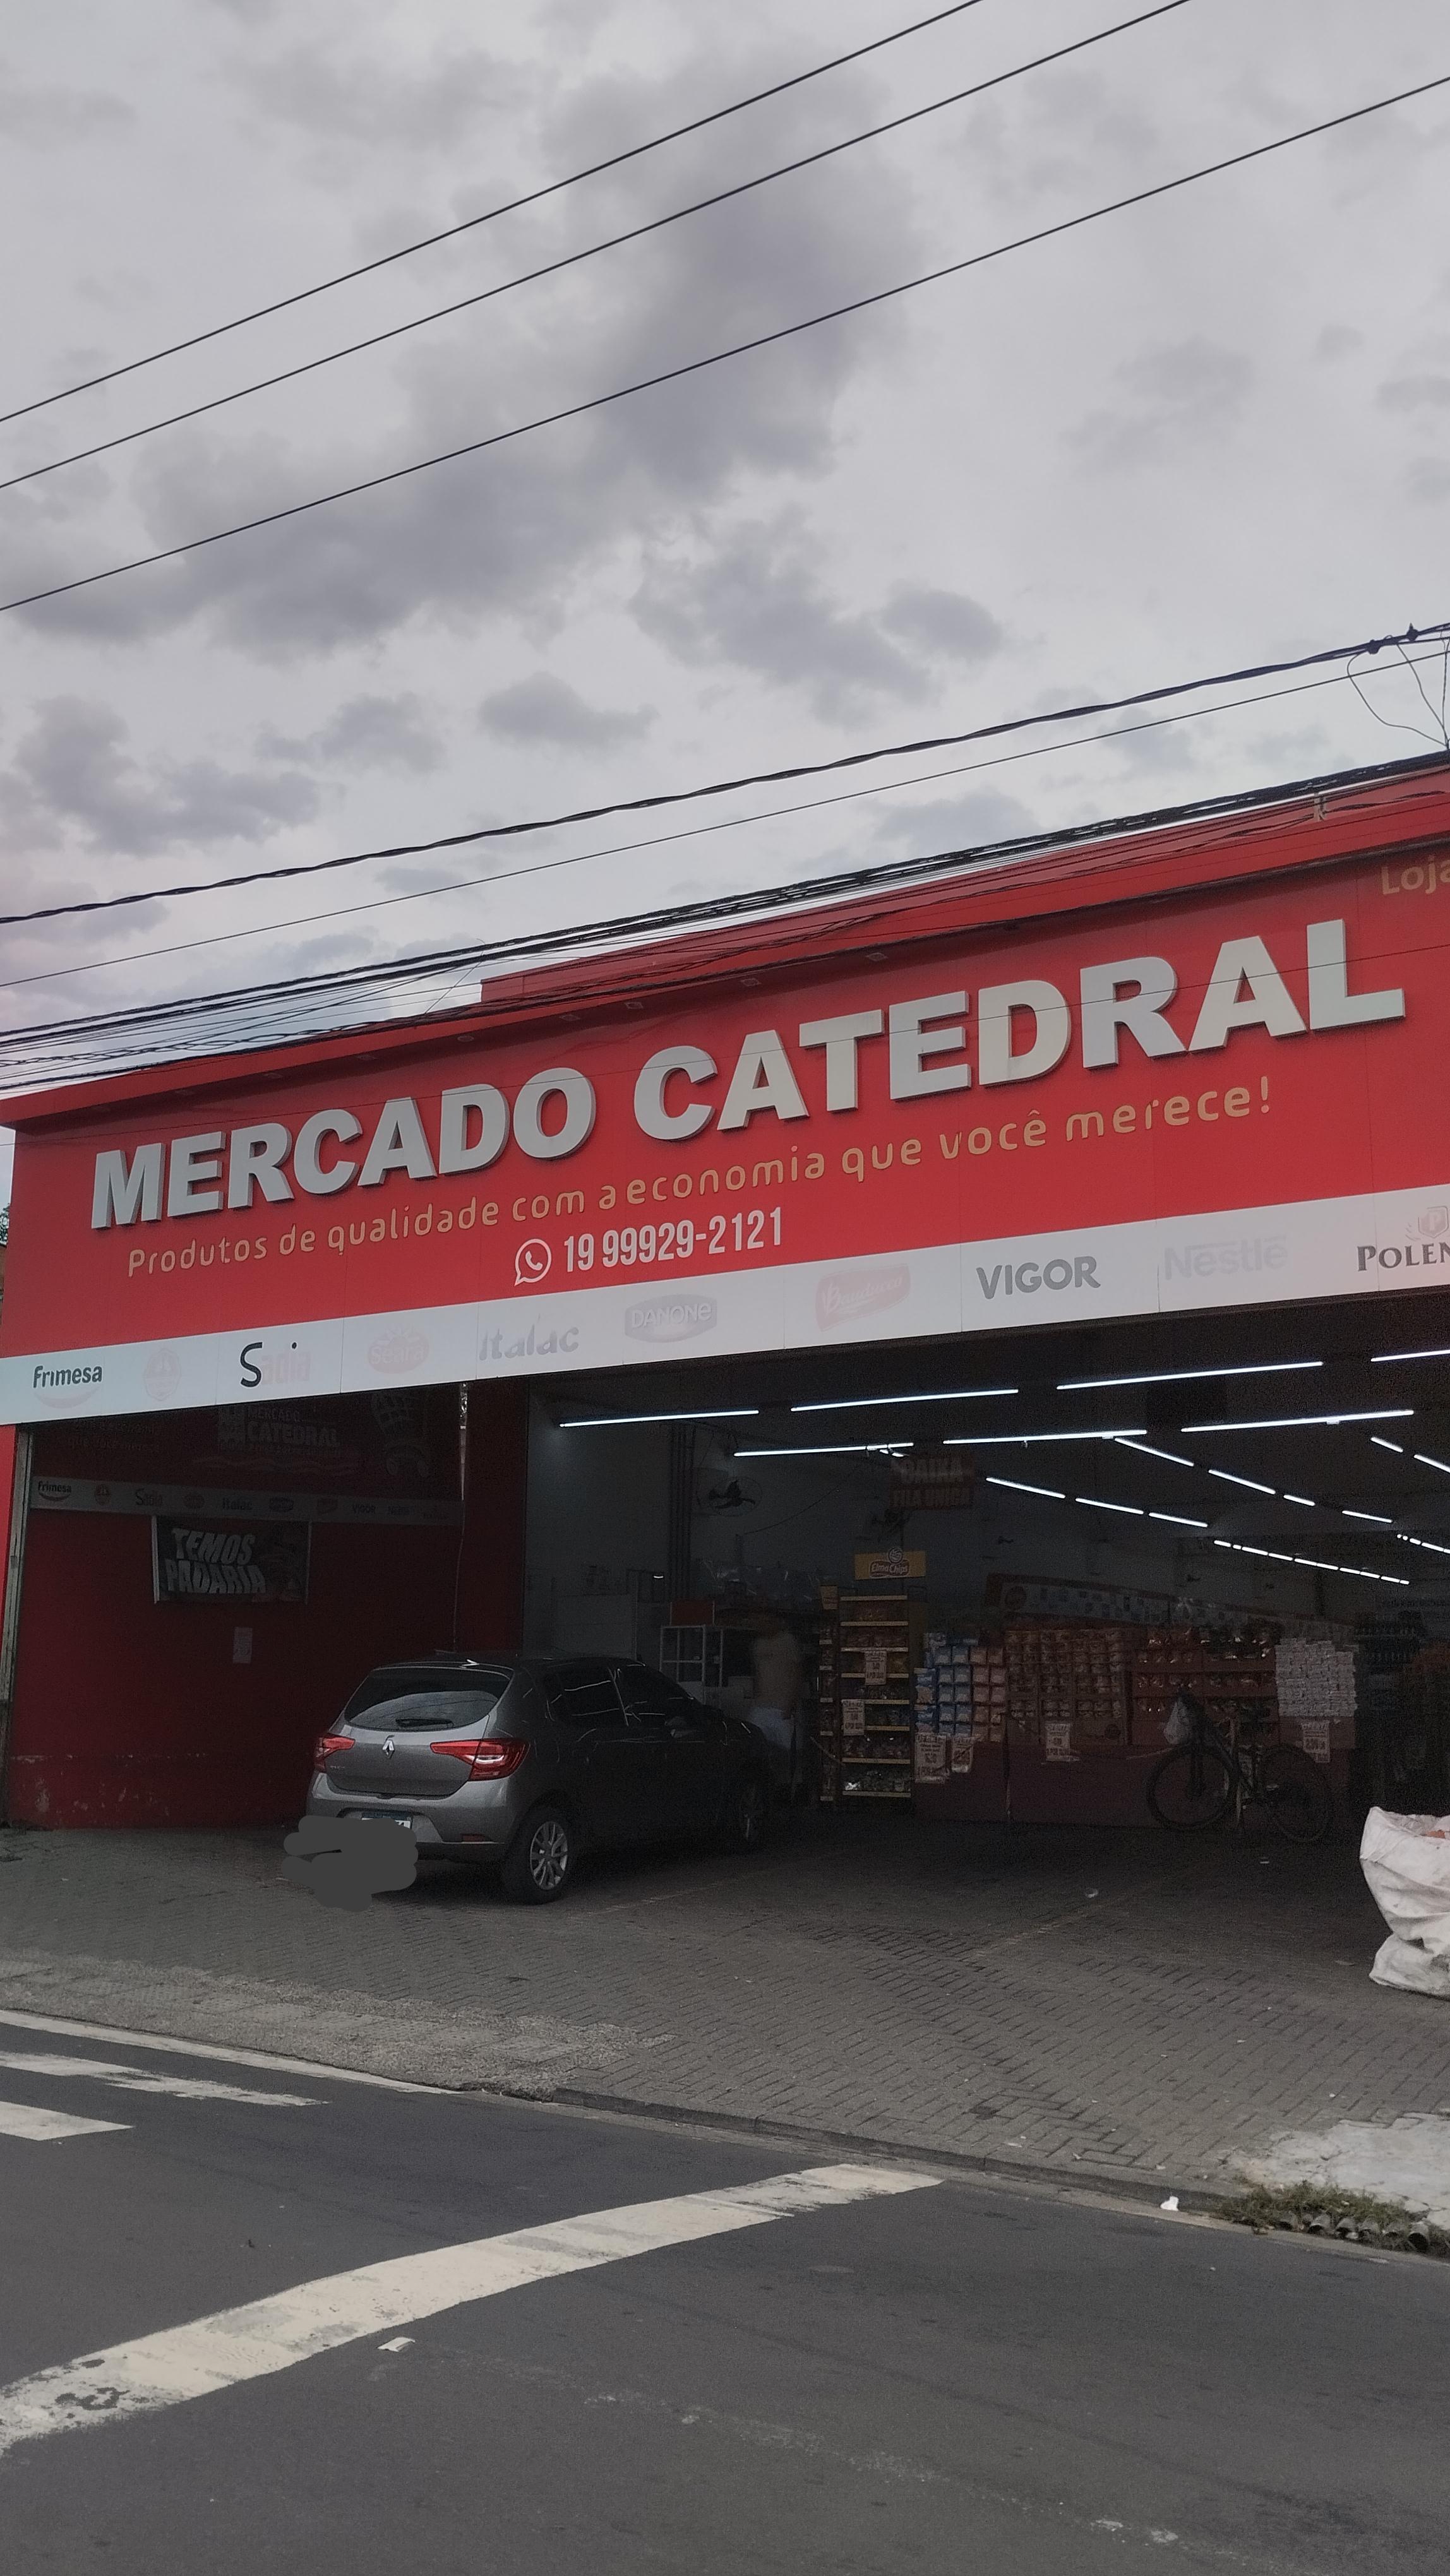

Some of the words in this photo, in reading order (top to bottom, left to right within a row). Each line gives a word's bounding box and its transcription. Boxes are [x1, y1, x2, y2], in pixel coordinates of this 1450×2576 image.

[91, 1067, 596, 1229] MERCADO
[634, 919, 1406, 1140] CATEDRAL
[128, 1234, 268, 1277] Produtos
[279, 1225, 316, 1256] de
[328, 1196, 499, 1256] qualidade
[512, 1189, 585, 1222] com
[842, 1138, 921, 1183] que
[940, 1109, 1047, 1160] você
[1066, 1076, 1270, 1142] merece!
[563, 1233, 594, 1272] 19
[602, 1207, 782, 1268] 99929-2121
[976, 1256, 1101, 1299] VIGOR
[171, 1527, 256, 1566] TEMOS
[164, 1558, 266, 1594] PADARIA
